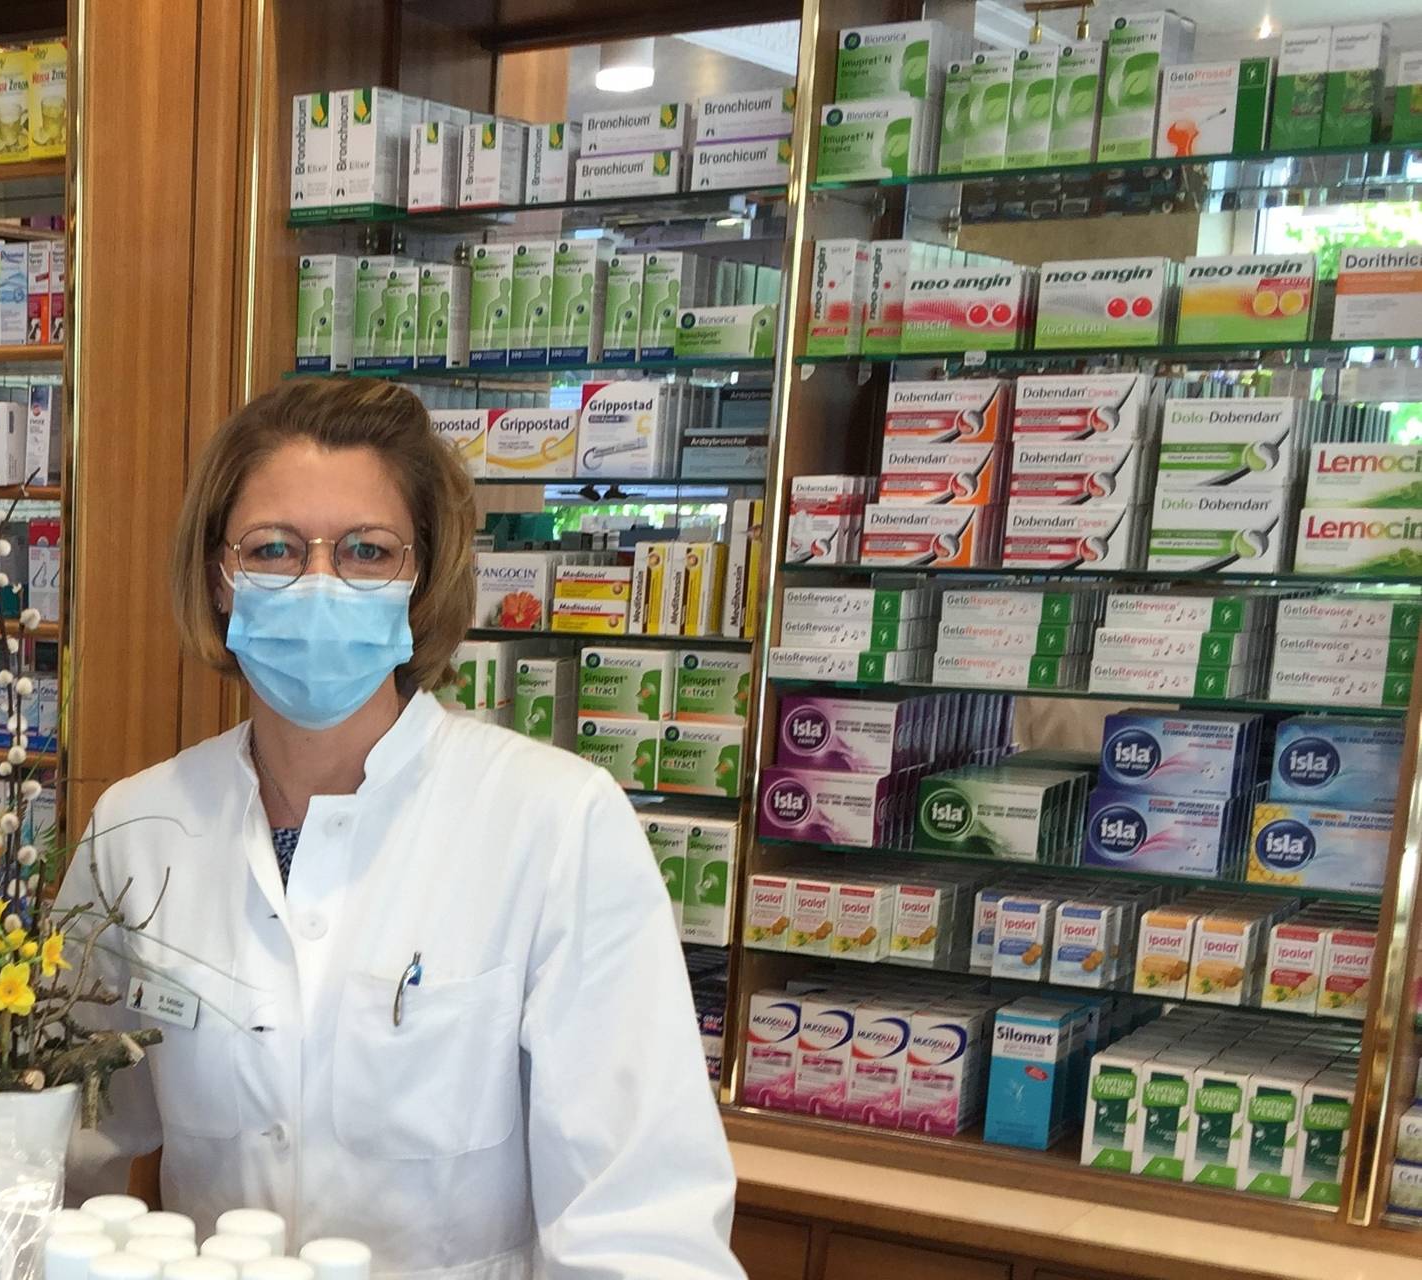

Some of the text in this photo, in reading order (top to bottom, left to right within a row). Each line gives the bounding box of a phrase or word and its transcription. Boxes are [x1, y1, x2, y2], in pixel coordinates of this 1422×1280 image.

[1150, 33, 1157, 41] N
[885, 55, 892, 65] N
[1170, 67, 1233, 82] GeloProsed
[704, 97, 770, 116] Bronchicum
[587, 112, 648, 131] Bronchicum
[295, 99, 306, 176] Bronchicum
[337, 95, 349, 172] Bronchicum
[866, 131, 874, 141] N
[413, 127, 422, 176] Bronchicum
[466, 127, 476, 185] Bronchicum
[531, 127, 543, 186] Bronchicum
[699, 148, 764, 165] Bronchicum
[307, 163, 328, 174] Elixir
[349, 161, 371, 171] Elixir
[582, 160, 642, 177] Bronchicum
[1044, 264, 1155, 283] neo angin
[1188, 259, 1304, 279] neo angin
[814, 247, 828, 320] neo angin
[870, 247, 883, 321] neo angin
[909, 273, 1012, 292] neo angin
[893, 391, 950, 403] Dobendan
[1023, 387, 1085, 399] Dobendan
[588, 399, 653, 415] Grippostad
[500, 416, 570, 433] Grippostad
[888, 452, 944, 465] Dobendan
[1019, 451, 1081, 464] Dobendan
[795, 483, 838, 493] Dobendan
[870, 513, 927, 526] Dobendan
[1012, 515, 1074, 528] Dobendan
[482, 567, 538, 579] ANGOCIN
[730, 565, 743, 627] Meditonsin
[584, 672, 624, 686] Sinupret
[681, 673, 722, 687] Sinupret
[581, 685, 617, 697] extract
[680, 685, 715, 698] extract
[792, 719, 823, 739] isla
[580, 741, 620, 754] Sinupret
[663, 745, 703, 758] Sinupret
[1114, 742, 1152, 765] isla
[661, 757, 696, 770] extract
[1289, 750, 1329, 773] isla
[774, 790, 804, 810] isla
[932, 802, 964, 822] isla
[1100, 818, 1137, 841] isla
[1265, 832, 1305, 855] isla
[754, 891, 782, 904] ipalat
[798, 895, 826, 909] ipalat
[841, 901, 870, 914] ipalat
[901, 900, 930, 912] ipalat
[1004, 917, 1036, 931] ipalat
[1064, 922, 1096, 937] ipalat
[1149, 934, 1182, 948] ipalat
[1204, 939, 1238, 954] ipalat
[1278, 947, 1313, 961] ipalat
[1333, 952, 1369, 966] ipalat
[996, 1025, 1054, 1046] Silomat
[1101, 1085, 1129, 1097] VERDE
[1149, 1091, 1180, 1104] VERDE
[1202, 1096, 1234, 1110] VERDE
[1254, 1105, 1288, 1120] VERDE
[1310, 1113, 1345, 1127] VERDE
